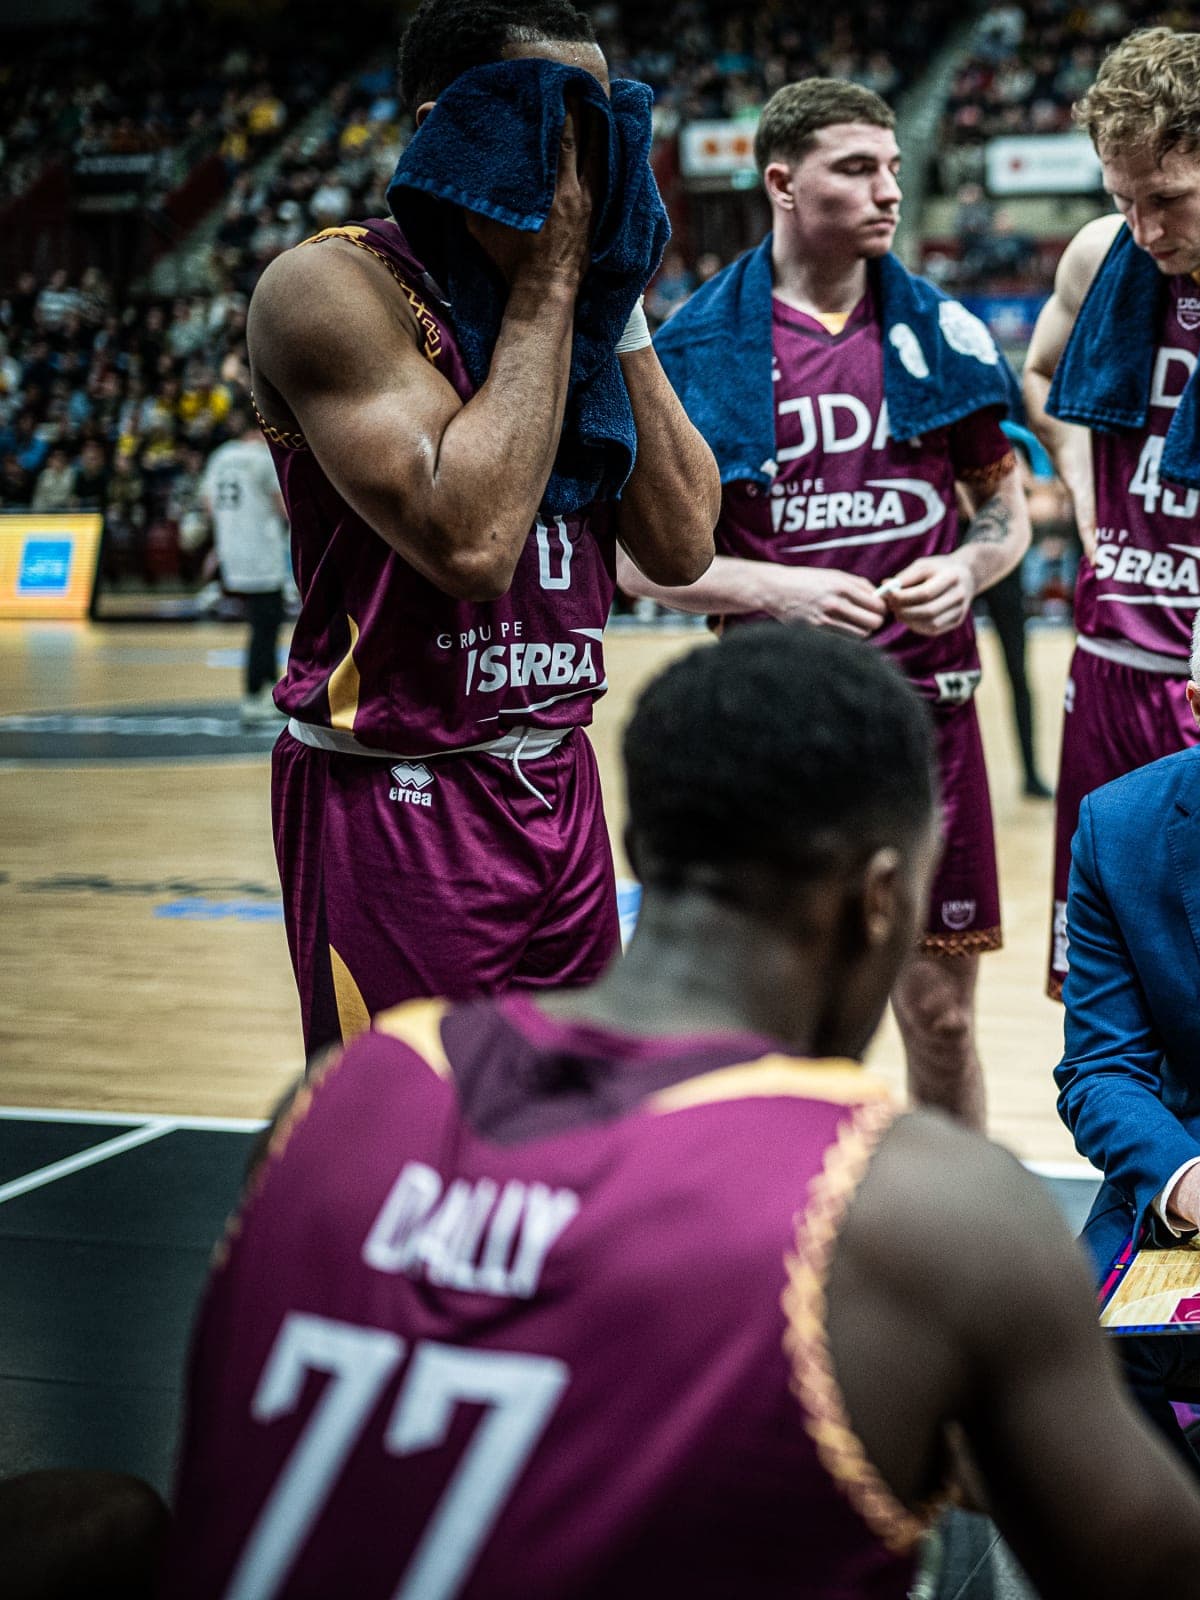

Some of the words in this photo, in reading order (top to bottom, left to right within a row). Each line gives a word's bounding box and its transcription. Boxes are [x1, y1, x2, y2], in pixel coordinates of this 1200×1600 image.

[1095, 543, 1200, 594] SERBA
[465, 643, 597, 696] ISERBA
[224, 1311, 570, 1600] 77
